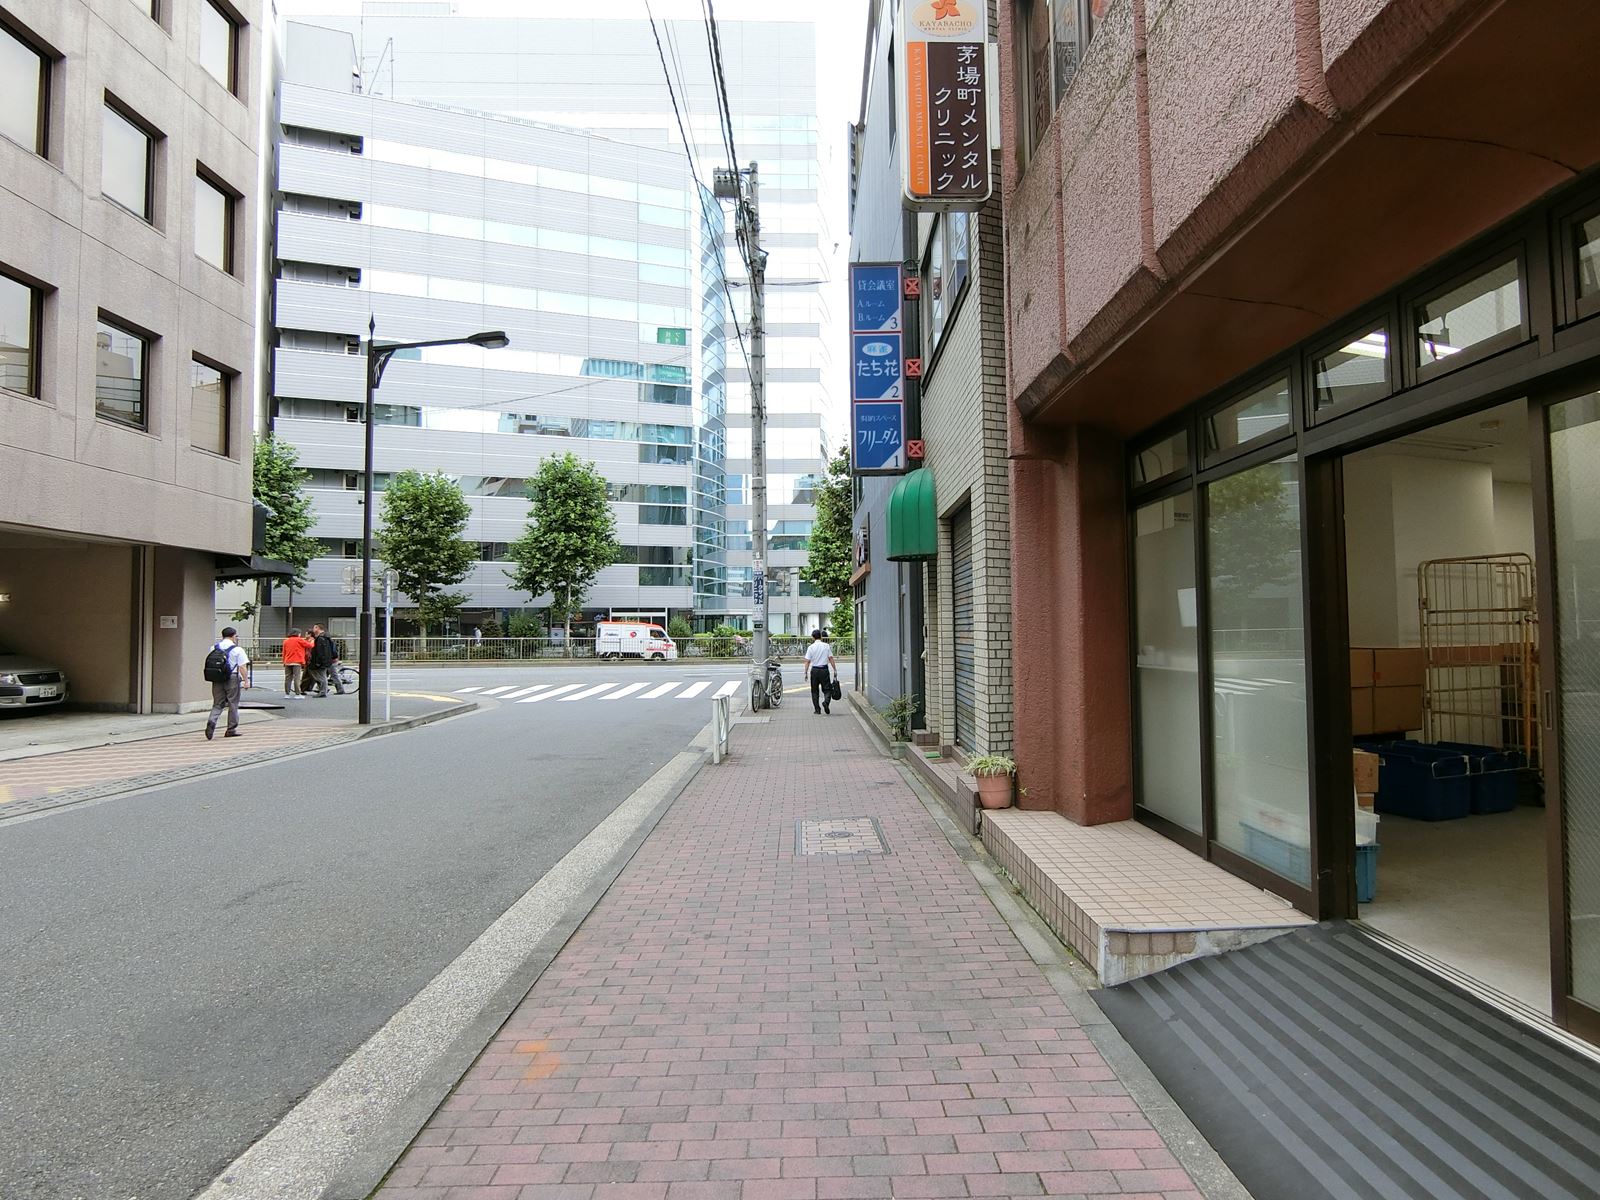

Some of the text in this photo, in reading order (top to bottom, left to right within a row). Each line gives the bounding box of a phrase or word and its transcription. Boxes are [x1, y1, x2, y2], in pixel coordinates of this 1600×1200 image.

[956, 46, 982, 190] 茅場町メンタル
[934, 88, 956, 190] クリニック
[858, 280, 896, 291] 貸会議室
[890, 316, 898, 329] 3
[856, 359, 899, 377] たち花
[890, 385, 899, 398] 2
[858, 427, 900, 452] フリーダム
[894, 454, 899, 467] 1
